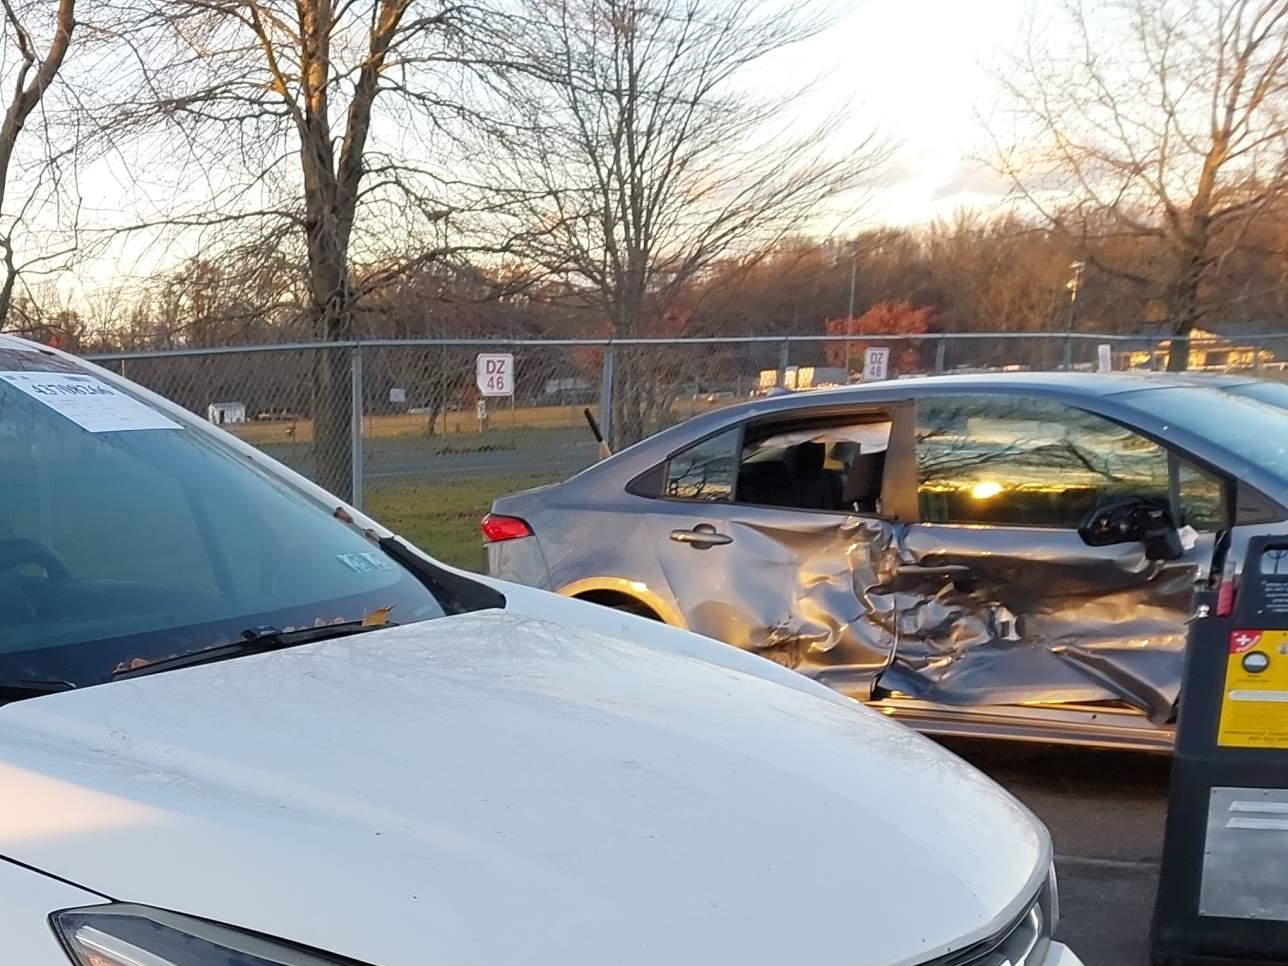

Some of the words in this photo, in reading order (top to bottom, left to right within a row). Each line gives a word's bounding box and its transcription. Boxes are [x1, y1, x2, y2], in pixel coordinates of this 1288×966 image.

[870, 352, 884, 365] DZ
[486, 360, 505, 374] DZ
[487, 376, 504, 390] 46
